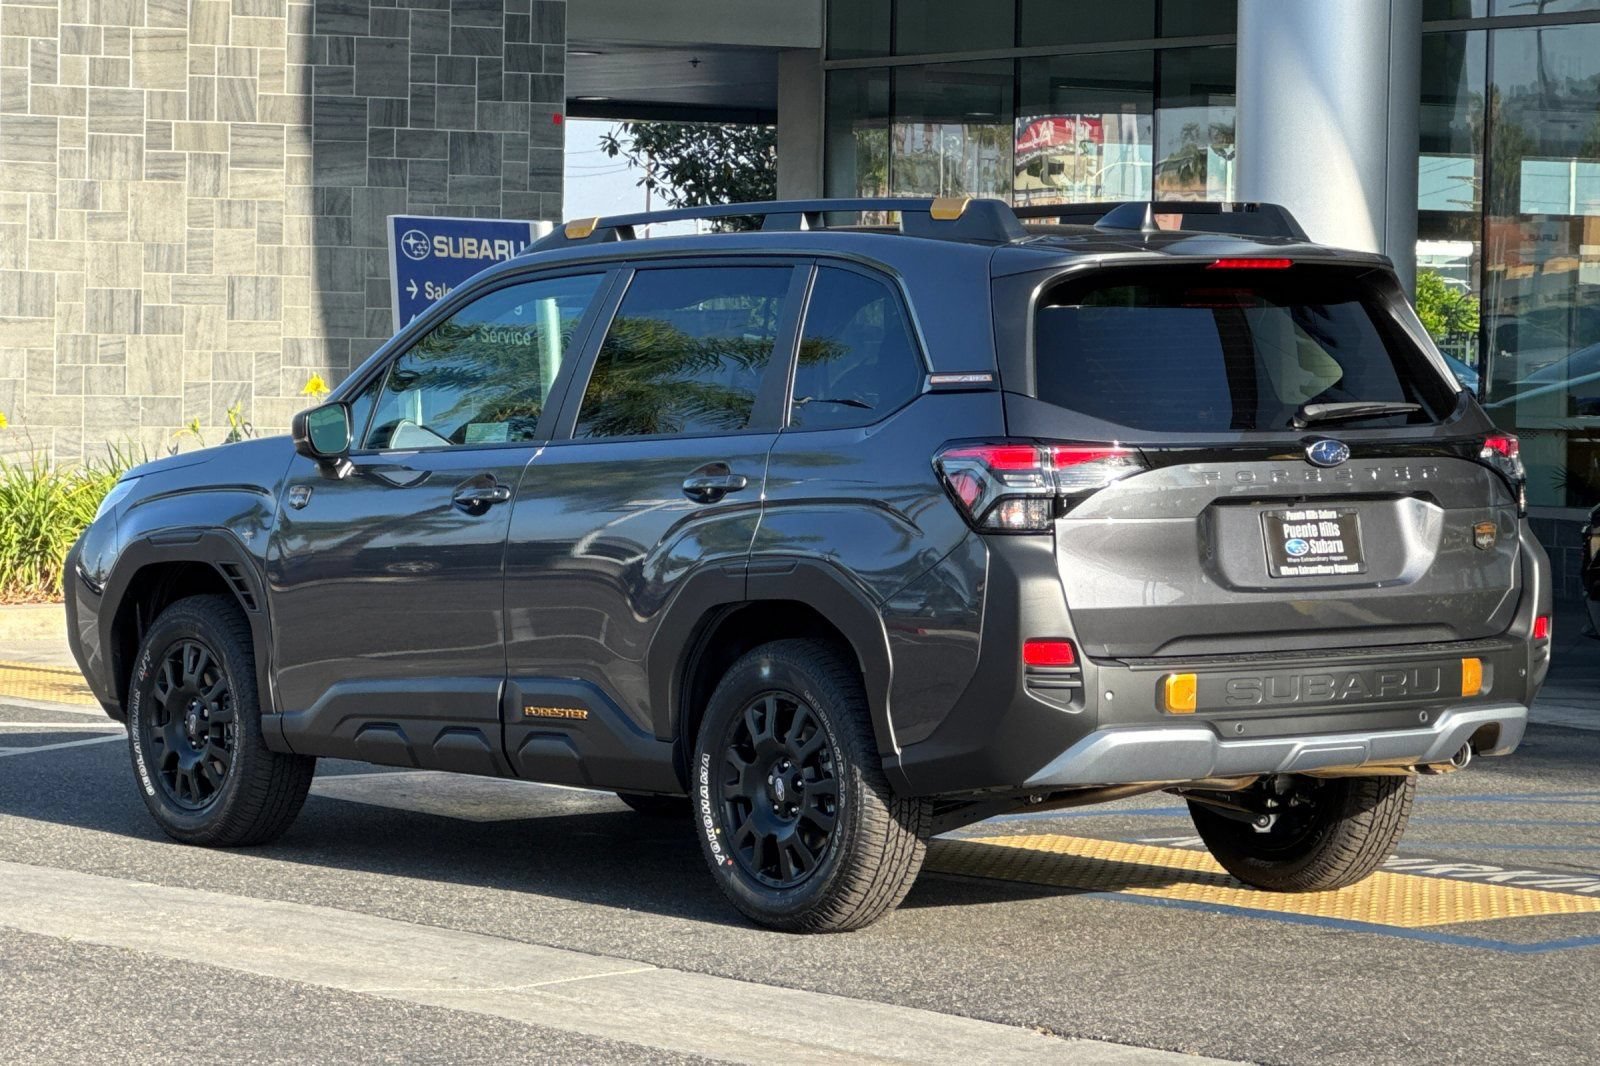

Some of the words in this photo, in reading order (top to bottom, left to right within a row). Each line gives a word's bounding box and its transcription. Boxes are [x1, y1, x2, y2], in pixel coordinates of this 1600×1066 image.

[480, 325, 531, 345] Service
[1200, 465, 1439, 485] FORESTER
[1283, 523, 1318, 538] Puente
[1319, 521, 1340, 537] Hills
[1309, 539, 1344, 554] Subaru
[1225, 667, 1440, 704] SUBARU
[525, 706, 588, 719] FORESTER
[131, 689, 155, 796] GEOLANDAR
[804, 690, 846, 809] GEOLANDAR
[699, 753, 726, 866] YOKOHAMA
